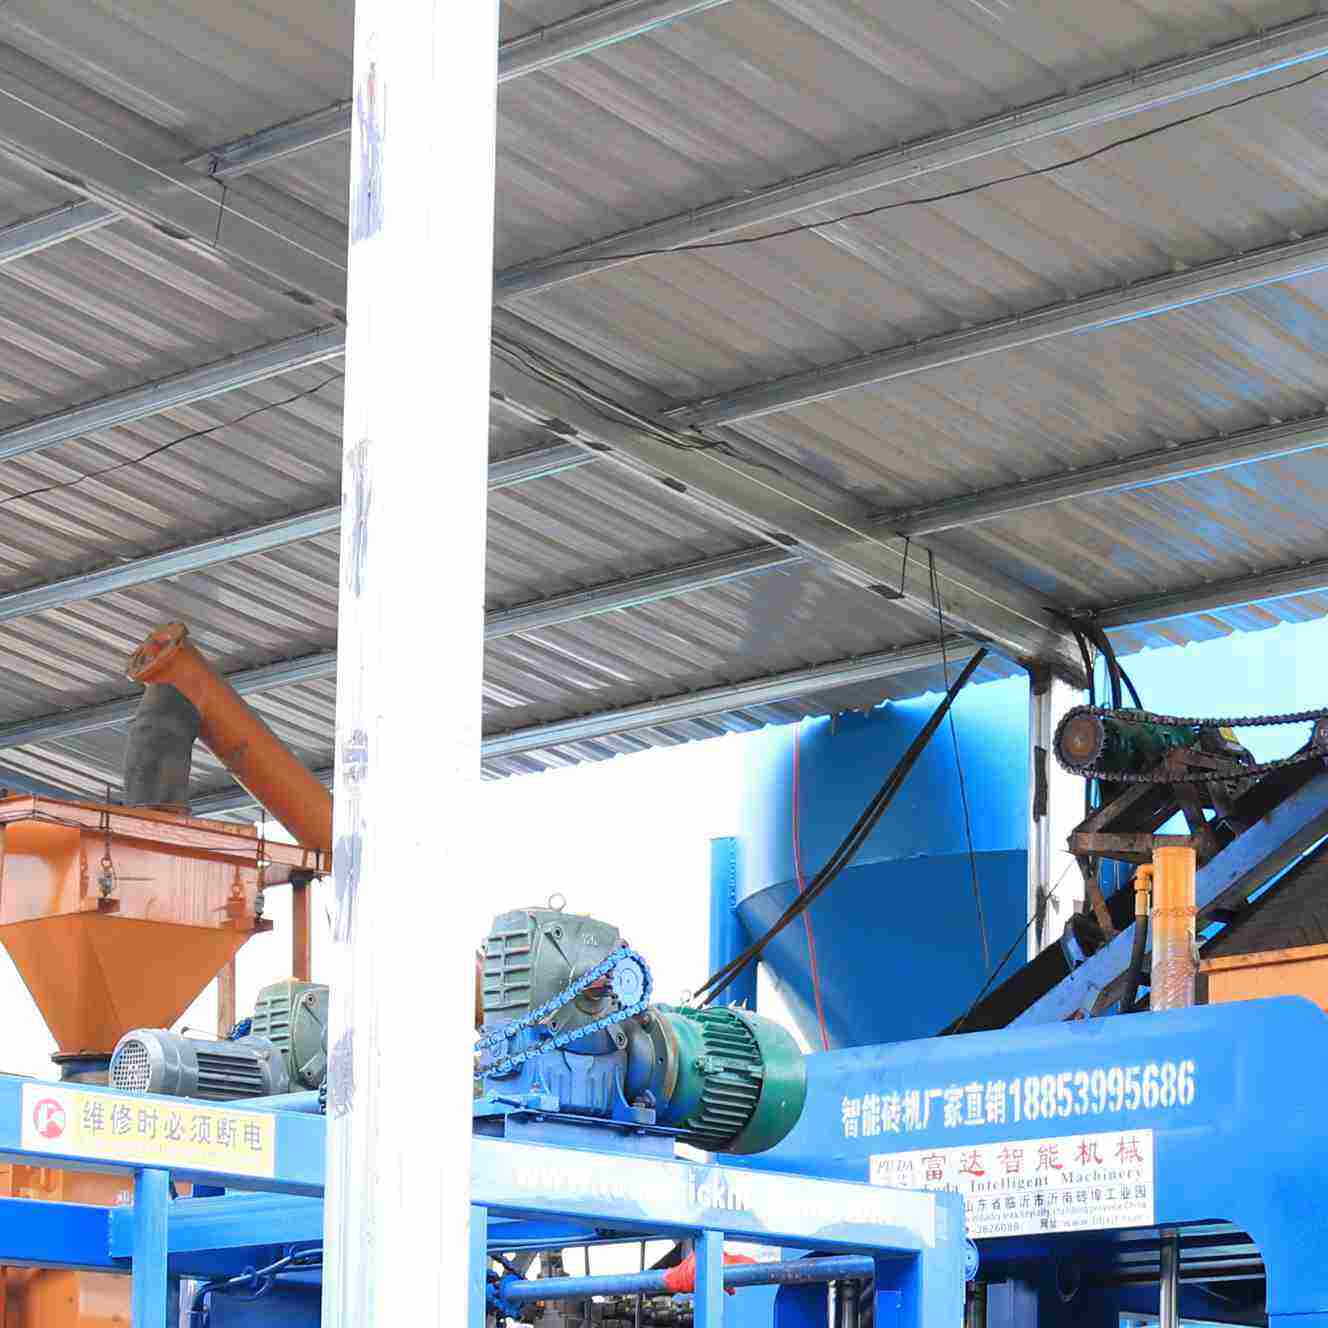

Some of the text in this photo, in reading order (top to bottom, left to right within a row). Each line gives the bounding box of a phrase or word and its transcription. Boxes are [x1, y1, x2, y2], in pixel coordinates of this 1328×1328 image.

[82, 1100, 264, 1151] 维修时必须断电
[922, 1135, 1145, 1181] 富达智能机械
[971, 1174, 1049, 1193] Intelligent
[1061, 1167, 1145, 1185] Machinery
